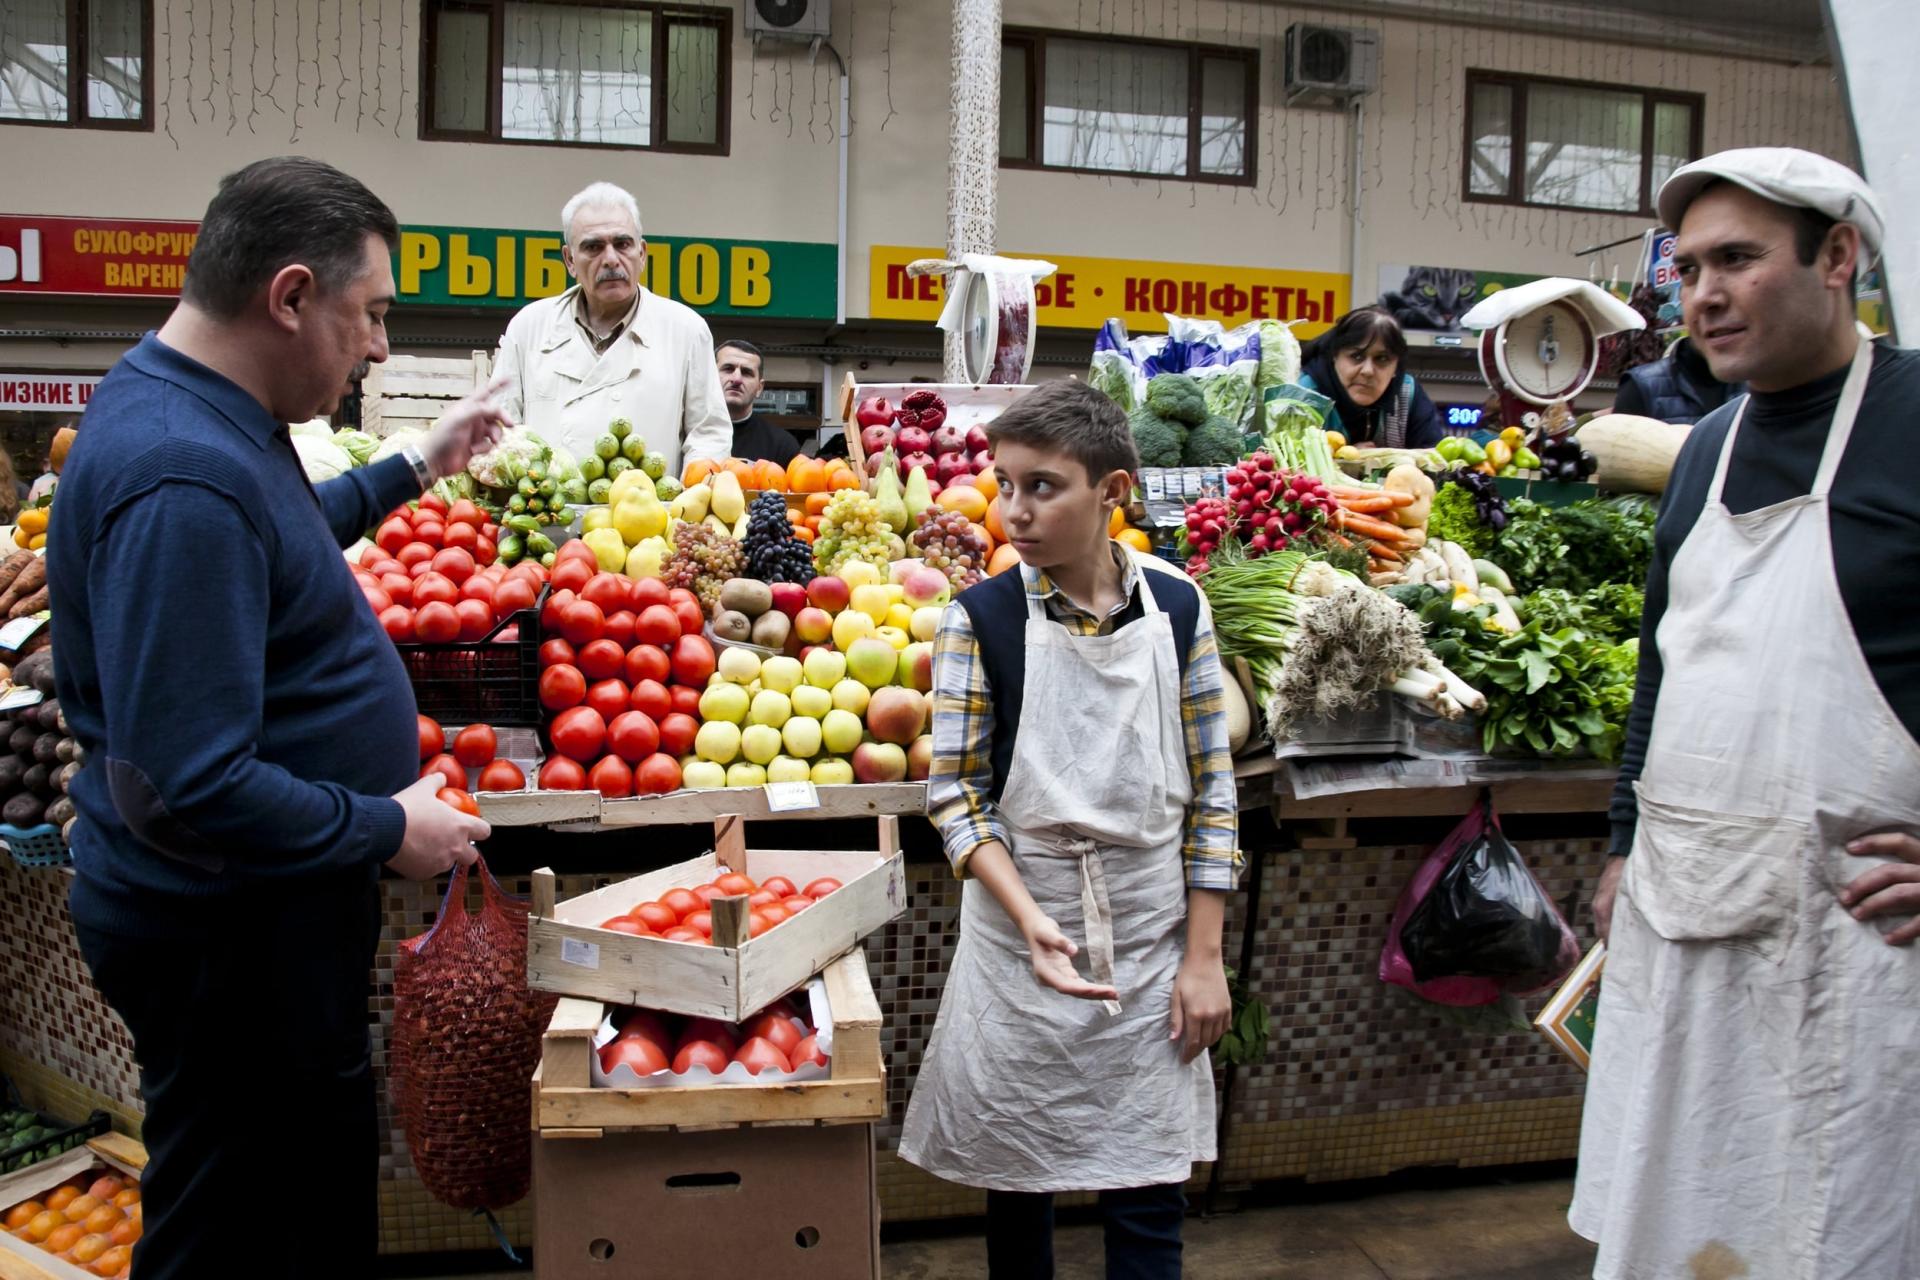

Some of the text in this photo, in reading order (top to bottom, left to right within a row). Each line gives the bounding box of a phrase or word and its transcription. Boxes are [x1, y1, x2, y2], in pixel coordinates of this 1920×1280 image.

[401, 231, 771, 307] РЫБЛОВ
[1124, 277, 1335, 323] КОНФЕТЫ
[0, 382, 73, 404] ИЗКИЕ
